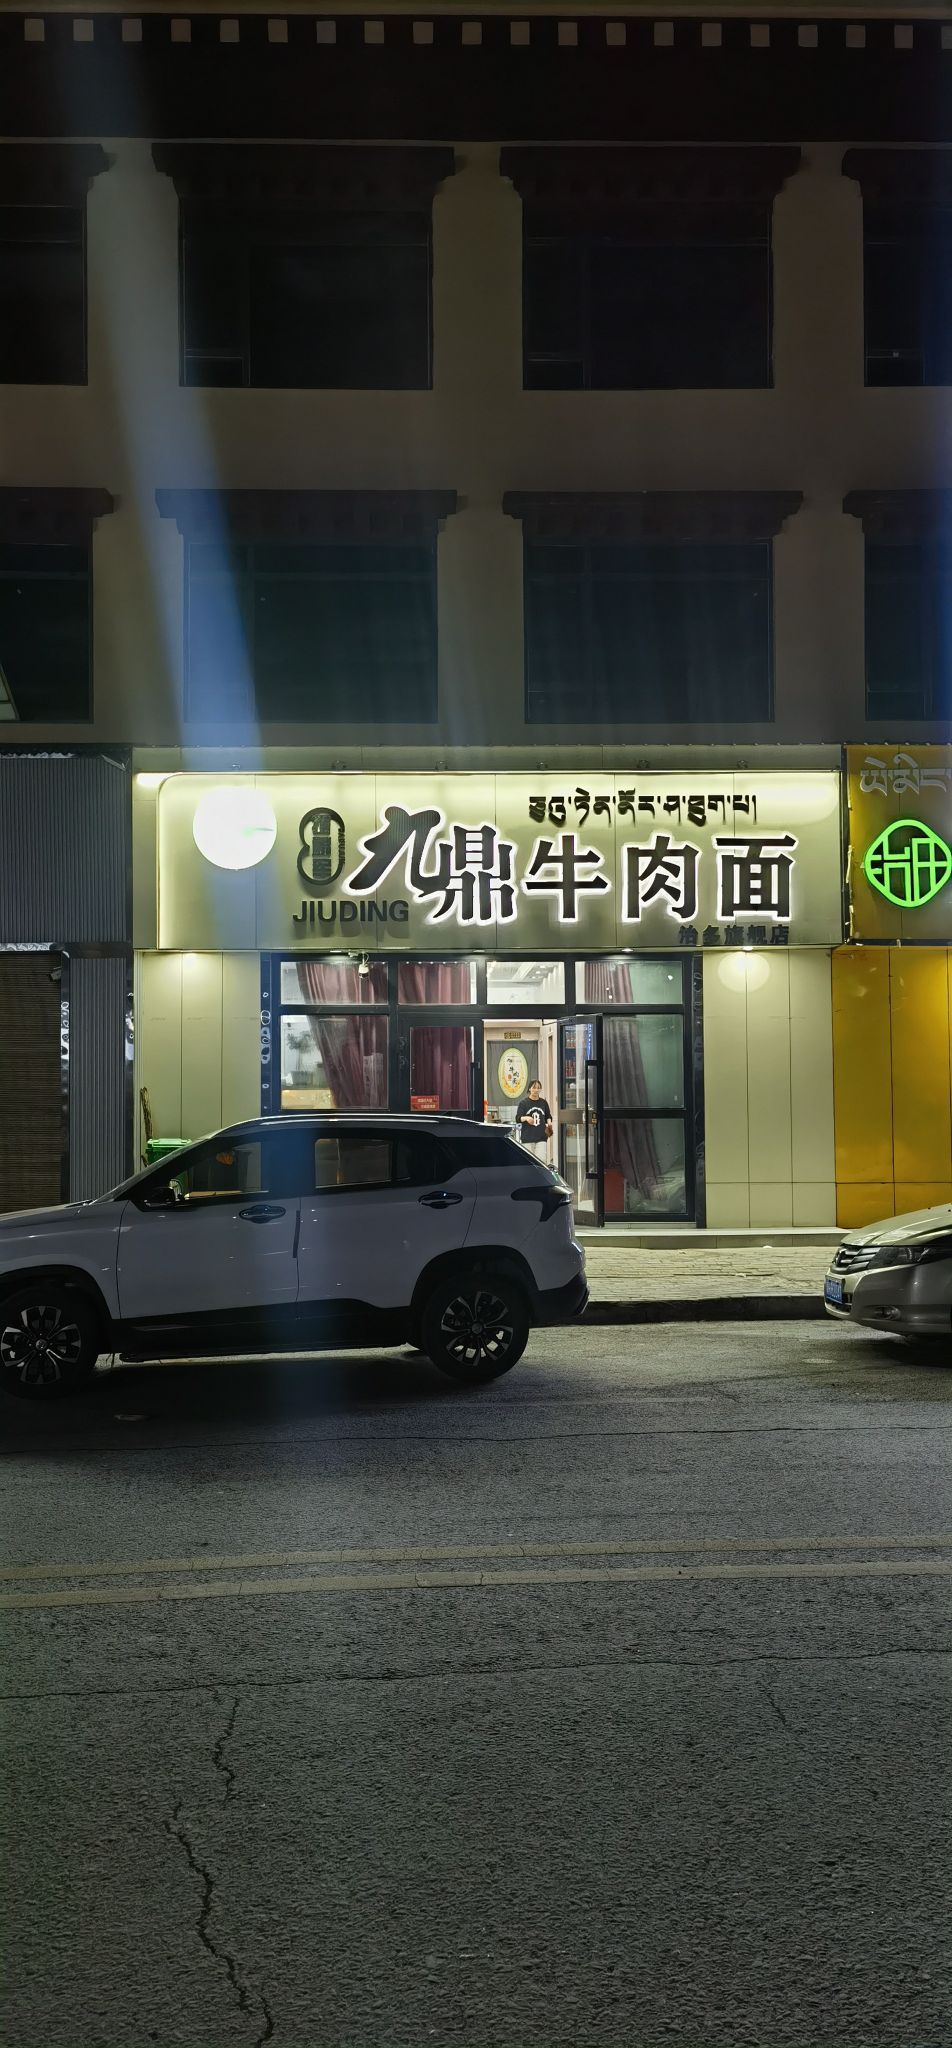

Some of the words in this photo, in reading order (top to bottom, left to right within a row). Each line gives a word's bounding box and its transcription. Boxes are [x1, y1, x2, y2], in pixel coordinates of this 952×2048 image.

[346, 805, 798, 922] 九鼎牛肉面
[293, 900, 409, 923] JIUDING
